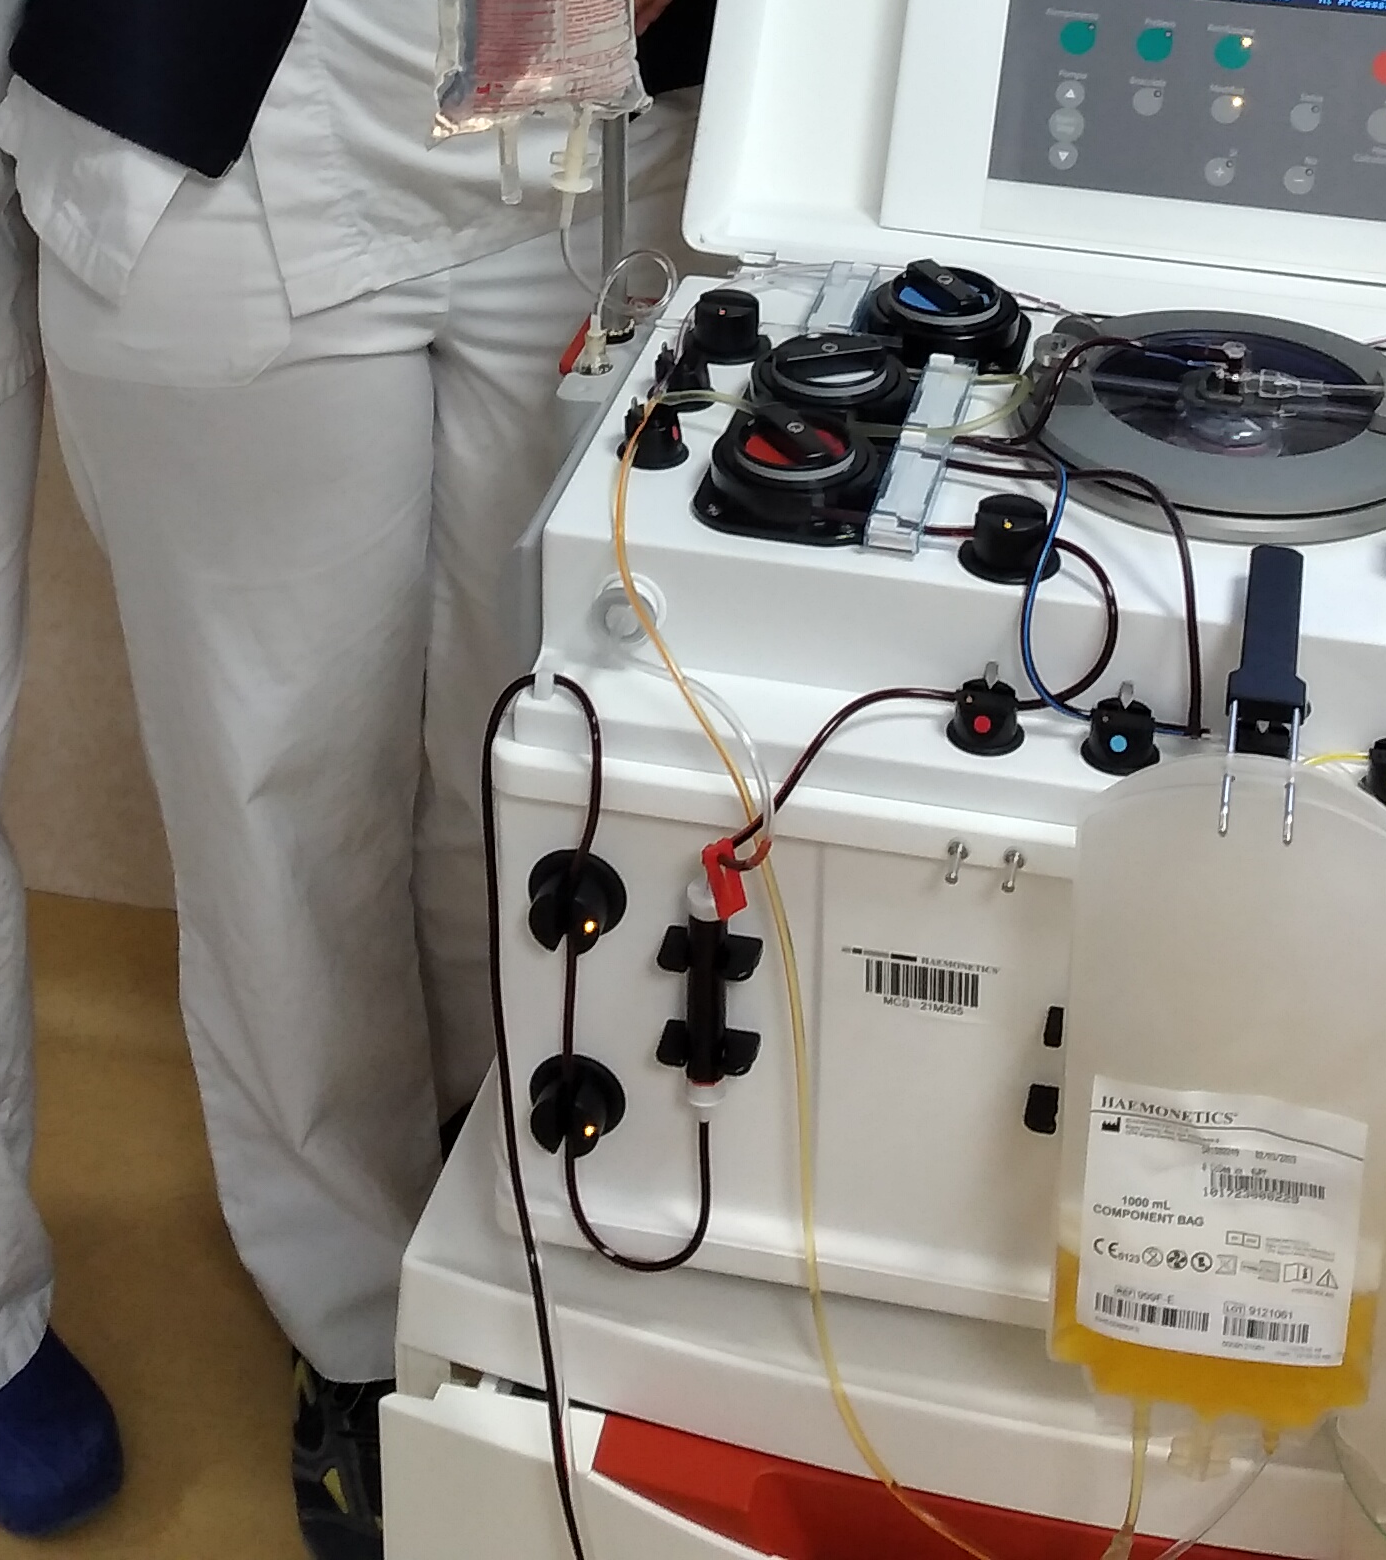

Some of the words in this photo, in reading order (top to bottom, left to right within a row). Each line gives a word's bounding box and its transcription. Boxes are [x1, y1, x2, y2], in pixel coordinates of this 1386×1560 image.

[921, 956, 1001, 975] HAEMONETICS
[1102, 1095, 1234, 1125] HAEMONETICS
[1121, 1195, 1150, 1208] 1000
[1152, 1200, 1171, 1210] mL
[1093, 1203, 1174, 1225] COMPONENT
[1177, 1214, 1205, 1227] BAG
